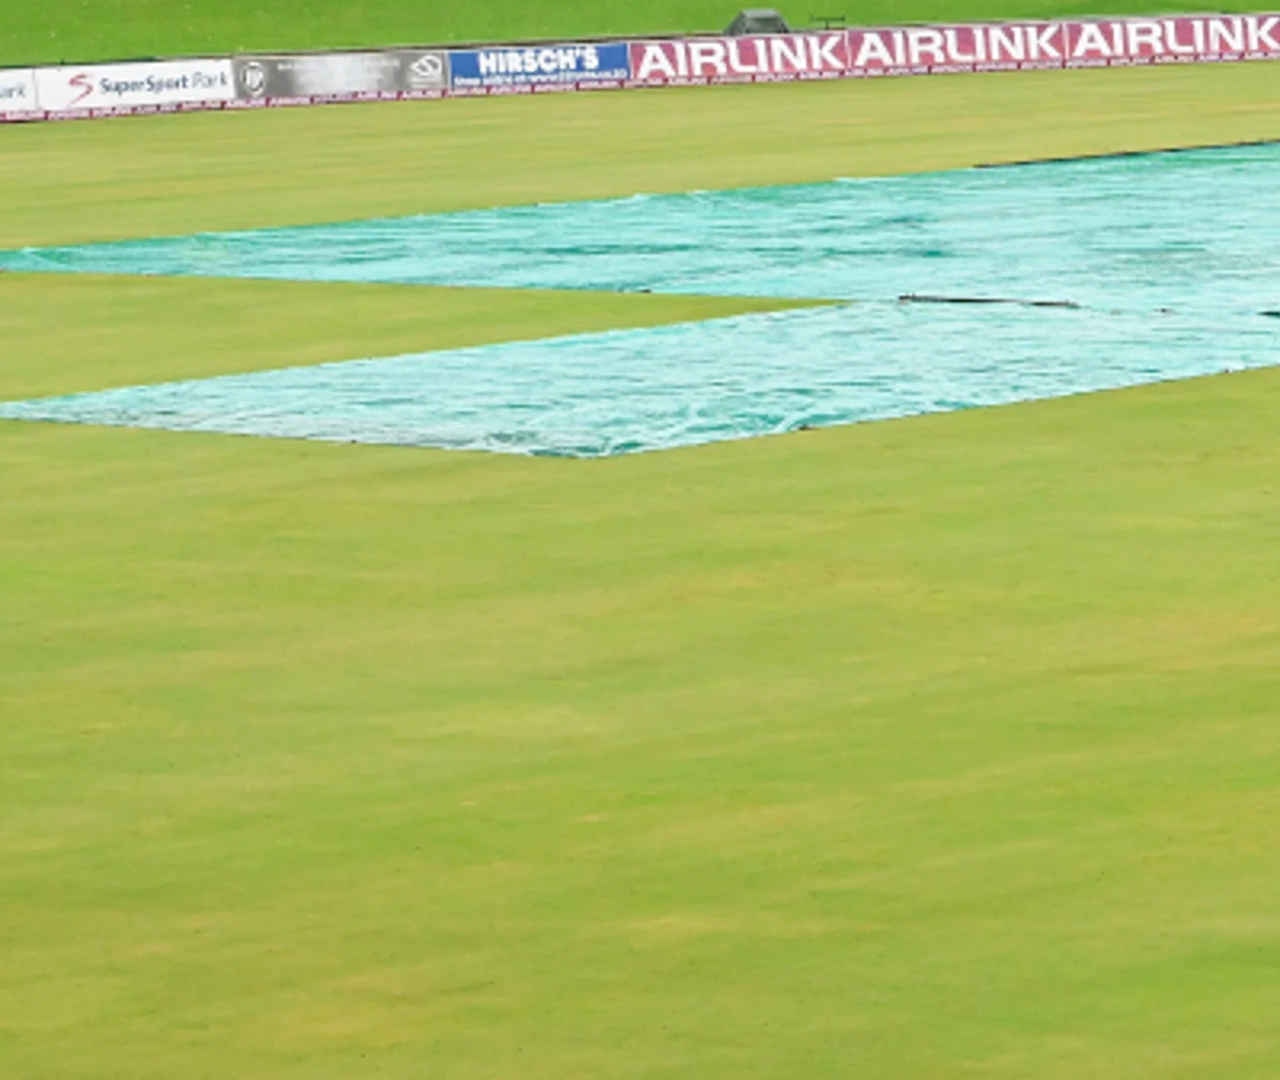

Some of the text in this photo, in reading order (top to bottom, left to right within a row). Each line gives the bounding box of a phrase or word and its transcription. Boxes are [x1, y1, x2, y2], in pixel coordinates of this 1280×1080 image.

[477, 46, 600, 75] HIRSCH'S
[639, 34, 848, 79] AIRLINK
[854, 23, 1063, 68] AIRLINK
[100, 70, 228, 96] SuperSport Park
